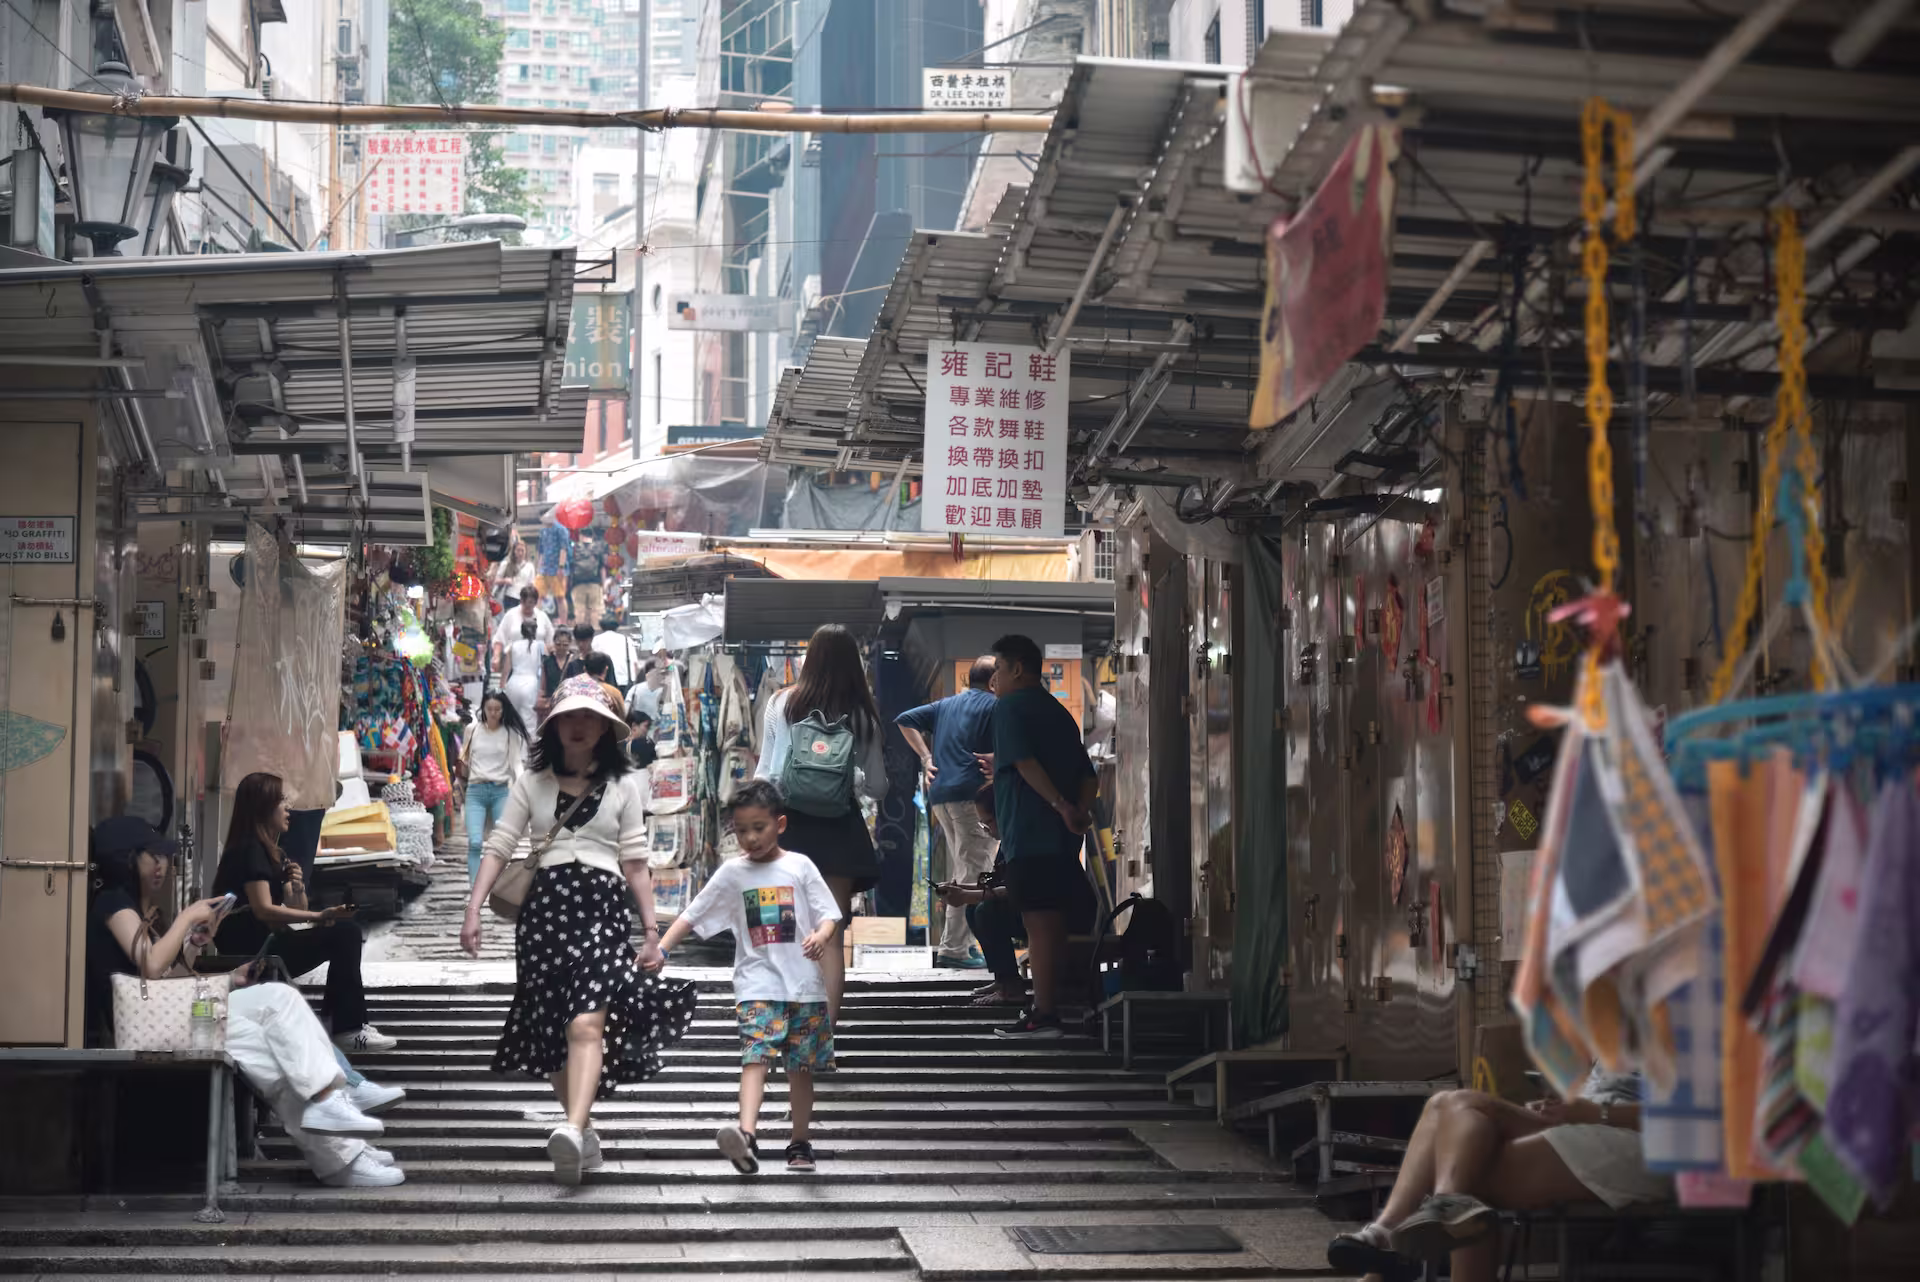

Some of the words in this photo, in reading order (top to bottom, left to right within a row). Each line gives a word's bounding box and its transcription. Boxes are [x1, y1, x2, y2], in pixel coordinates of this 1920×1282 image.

[947, 90, 962, 98] LEE
[967, 90, 984, 98] CHO
[988, 90, 1004, 98] KAY
[941, 350, 1056, 382] 雍記鞋
[949, 386, 1046, 410] 專業維修
[948, 415, 1045, 441] 各款舞鞋
[947, 446, 1044, 471] 換帶換扣
[946, 476, 1043, 501] 加底加墊
[945, 504, 1042, 530] 歡迎惠顧
[21, 530, 65, 538] GRAFFITI
